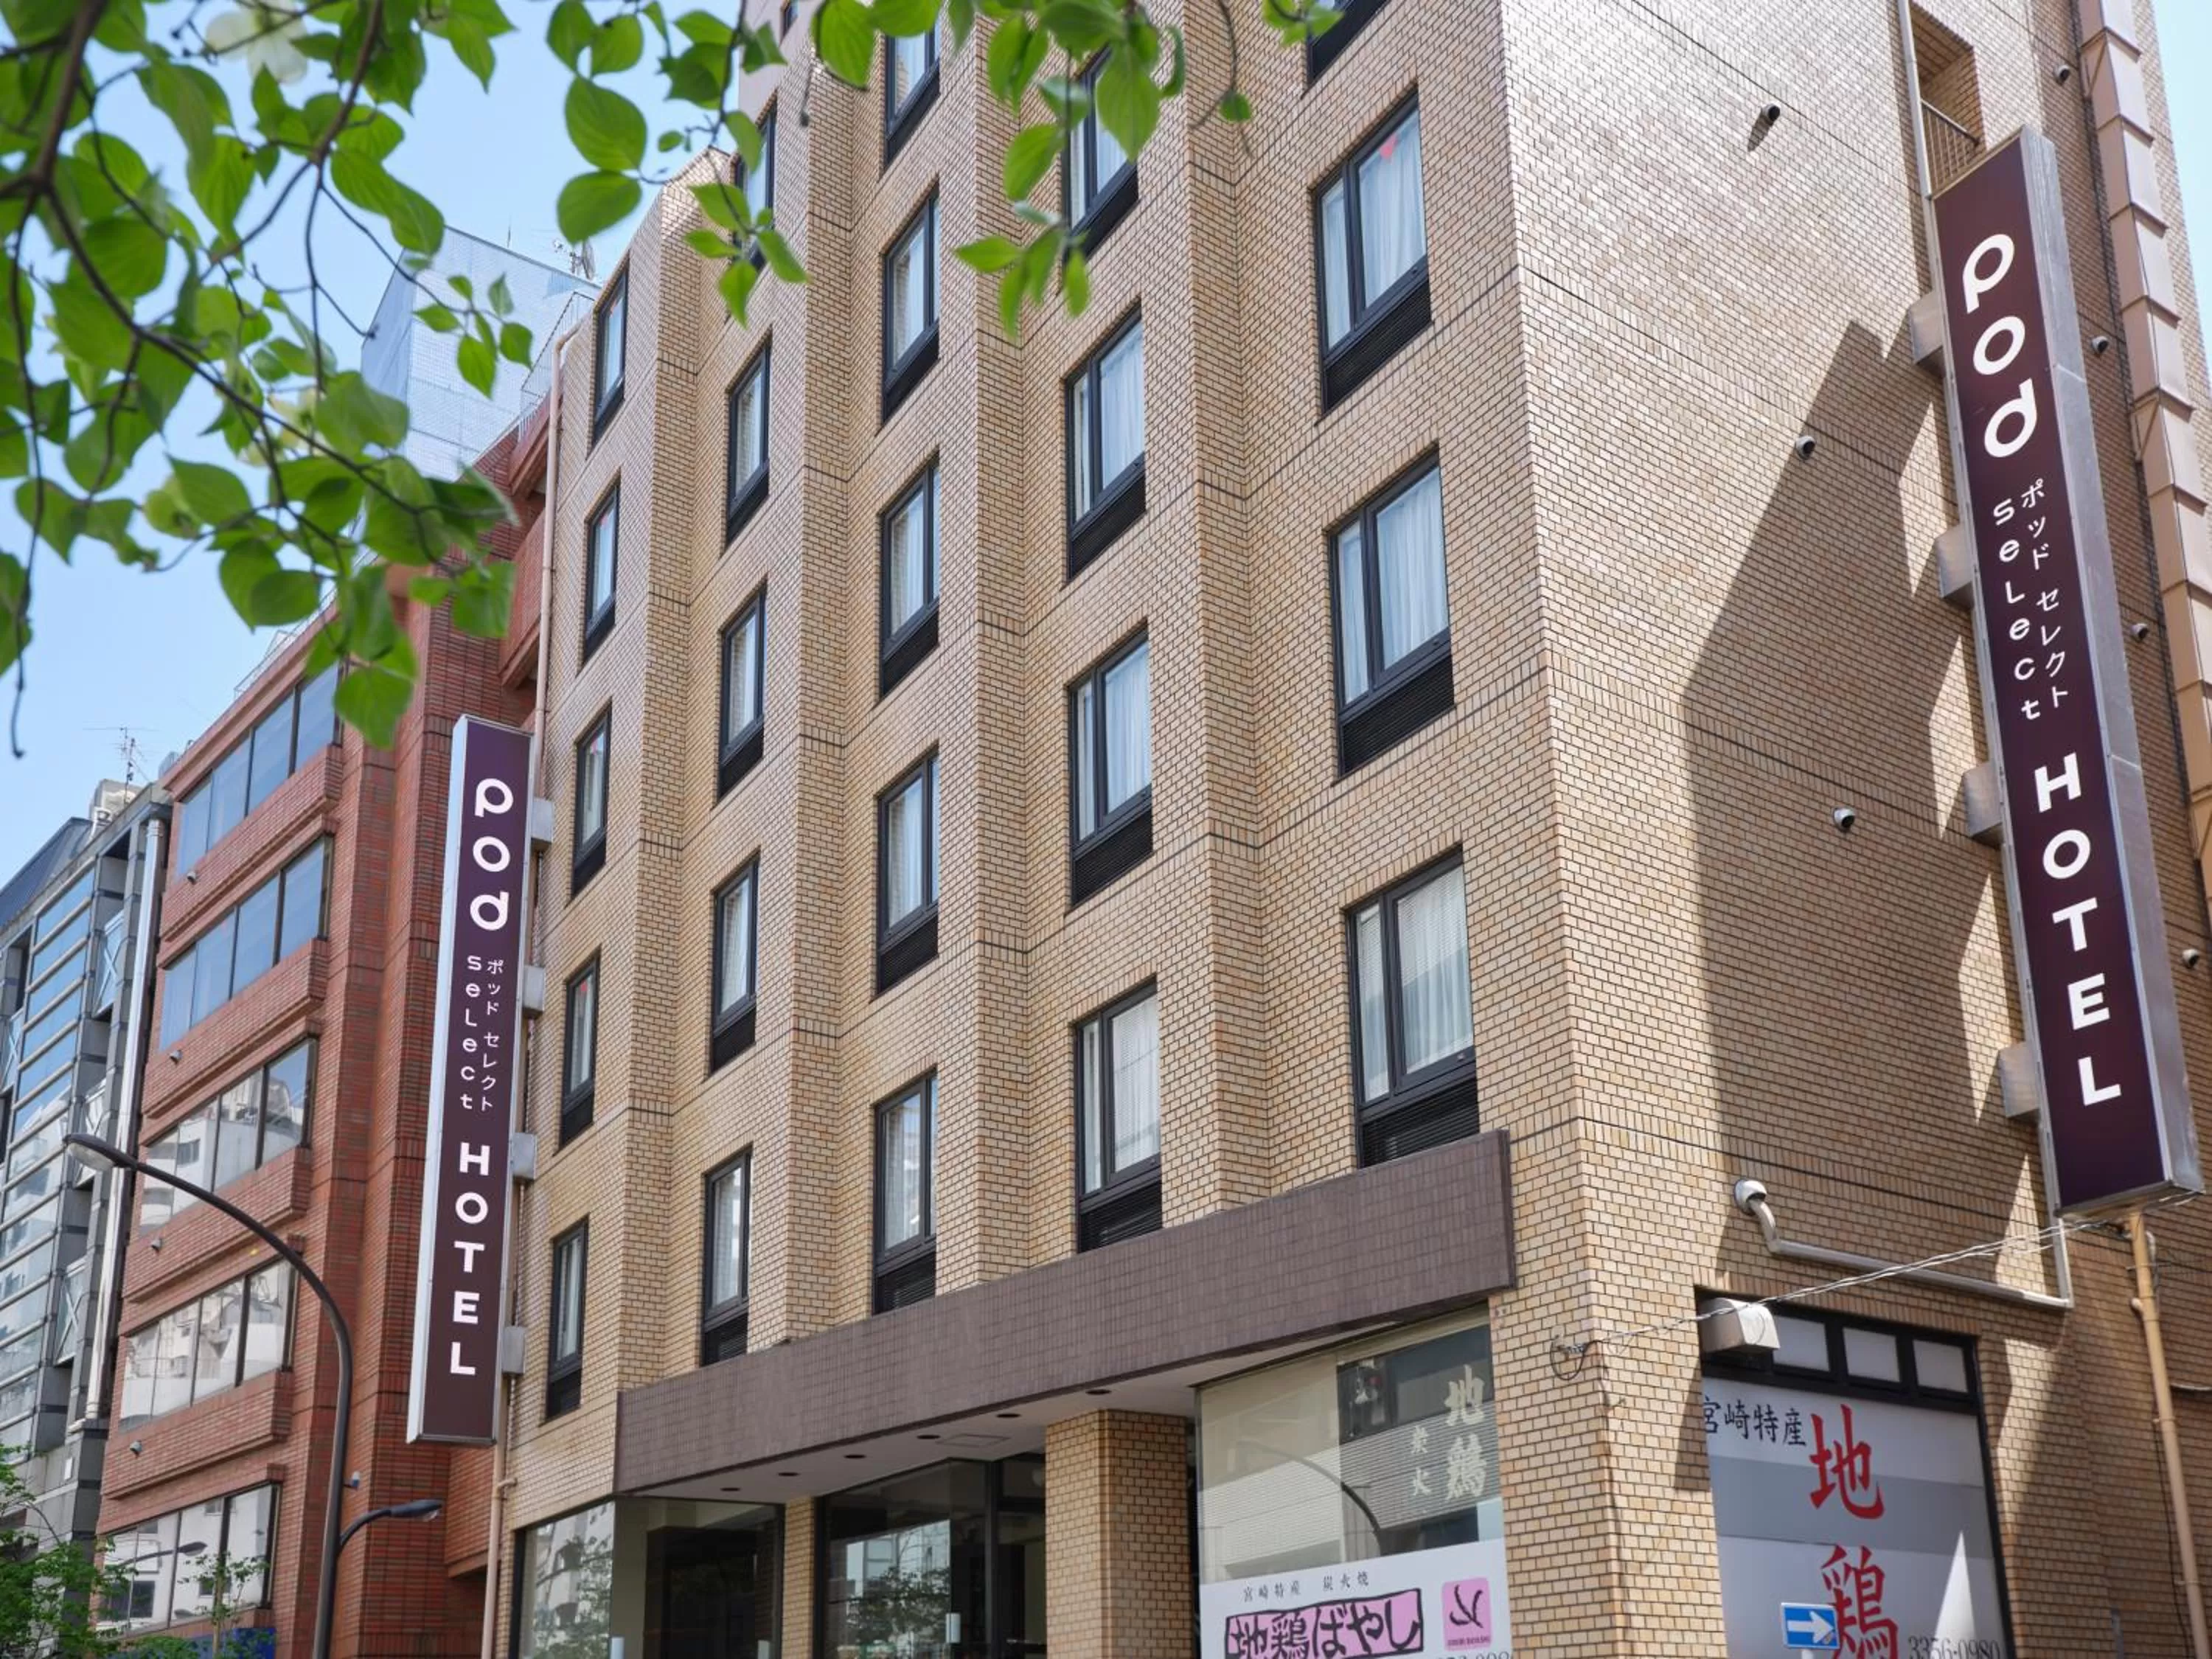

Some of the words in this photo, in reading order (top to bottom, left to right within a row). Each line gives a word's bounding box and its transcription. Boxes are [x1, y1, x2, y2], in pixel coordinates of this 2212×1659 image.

[1962, 234, 2037, 458] pod
[2034, 753, 2121, 1106] HOTEL
[470, 778, 514, 931] pod
[450, 1142, 491, 1376] HOTEL
